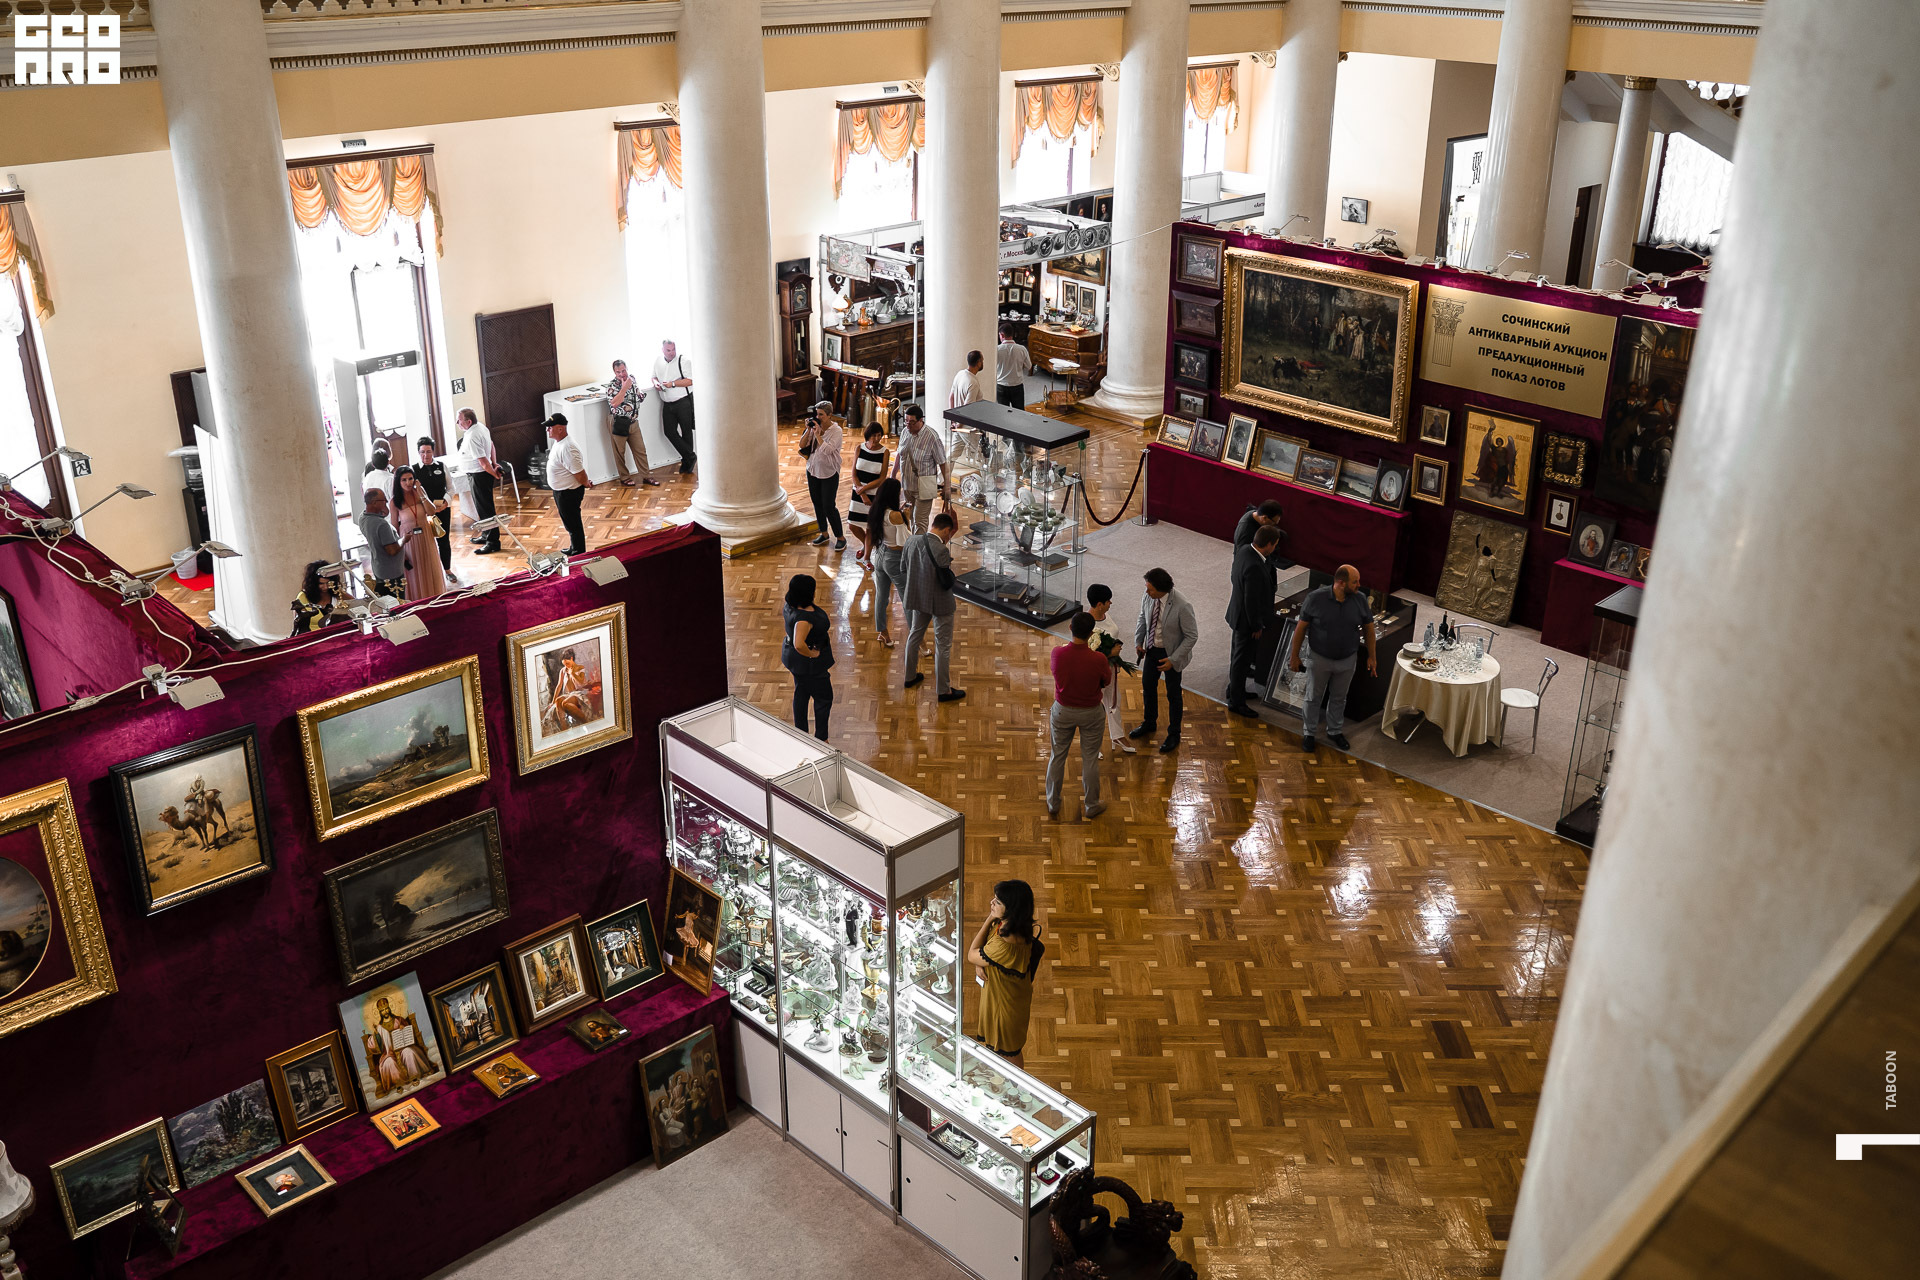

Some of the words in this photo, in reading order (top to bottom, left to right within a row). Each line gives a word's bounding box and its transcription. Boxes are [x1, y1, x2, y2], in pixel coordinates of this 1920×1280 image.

[1501, 313, 1571, 335] СОЧИНСКИЙ
[1468, 326, 1551, 351] АНТИКВАРНЫЙ
[1553, 343, 1608, 361] АУКЦИОН
[1478, 346, 1585, 376] ПРЕДАУКЦИОННЫЙ
[1491, 368, 1528, 383] ПОКАЗ
[1530, 376, 1566, 391] ЛОТОВ
